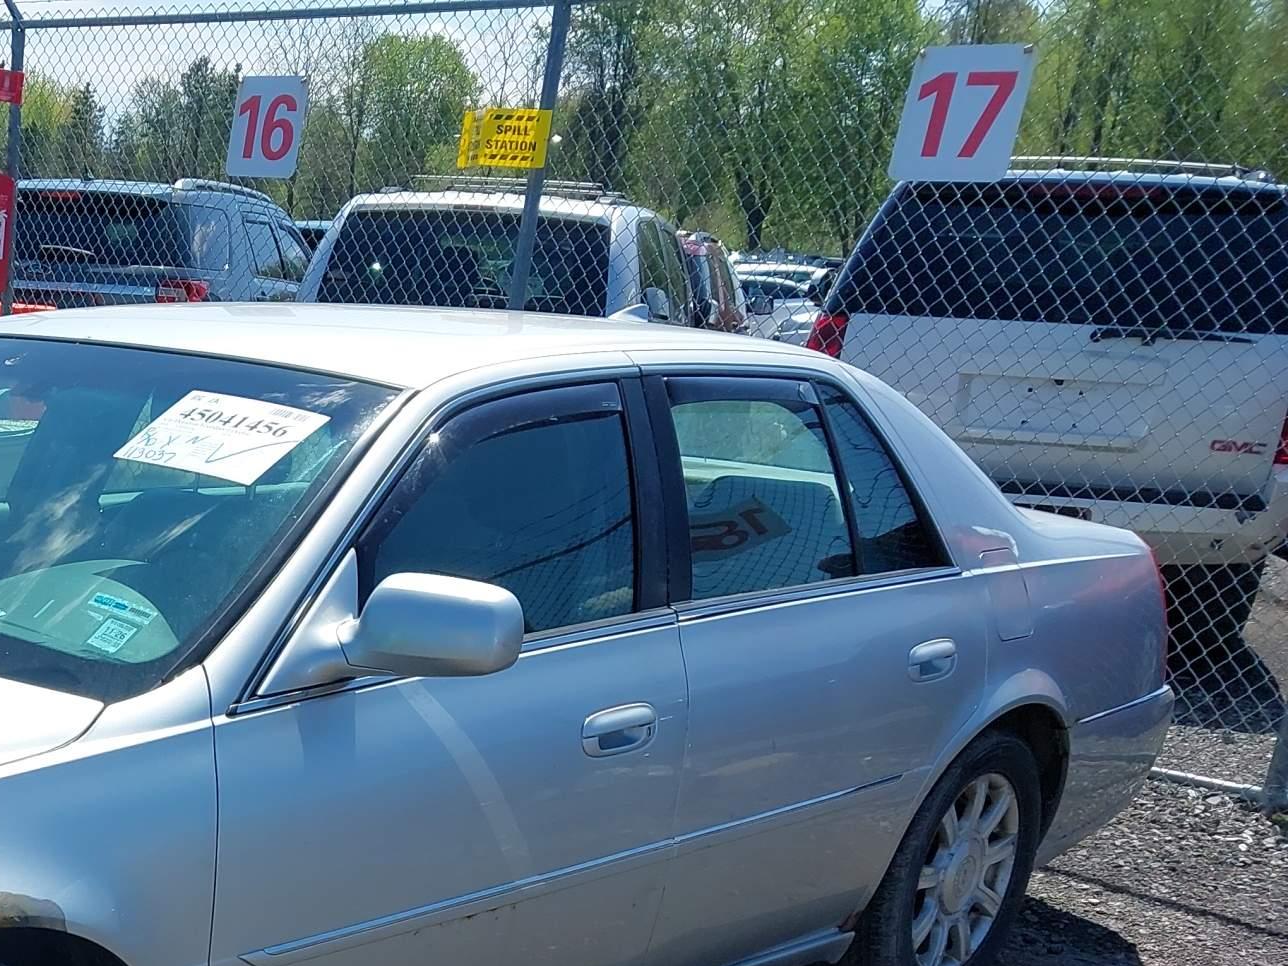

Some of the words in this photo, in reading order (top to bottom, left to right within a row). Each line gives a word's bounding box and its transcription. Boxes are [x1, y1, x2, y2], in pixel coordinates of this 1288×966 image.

[917, 70, 1020, 158] 17
[238, 93, 298, 161] 16
[495, 124, 532, 137] SPILL
[484, 138, 537, 152] STATION
[179, 406, 293, 438] 45041456
[1209, 439, 1268, 455] GMC
